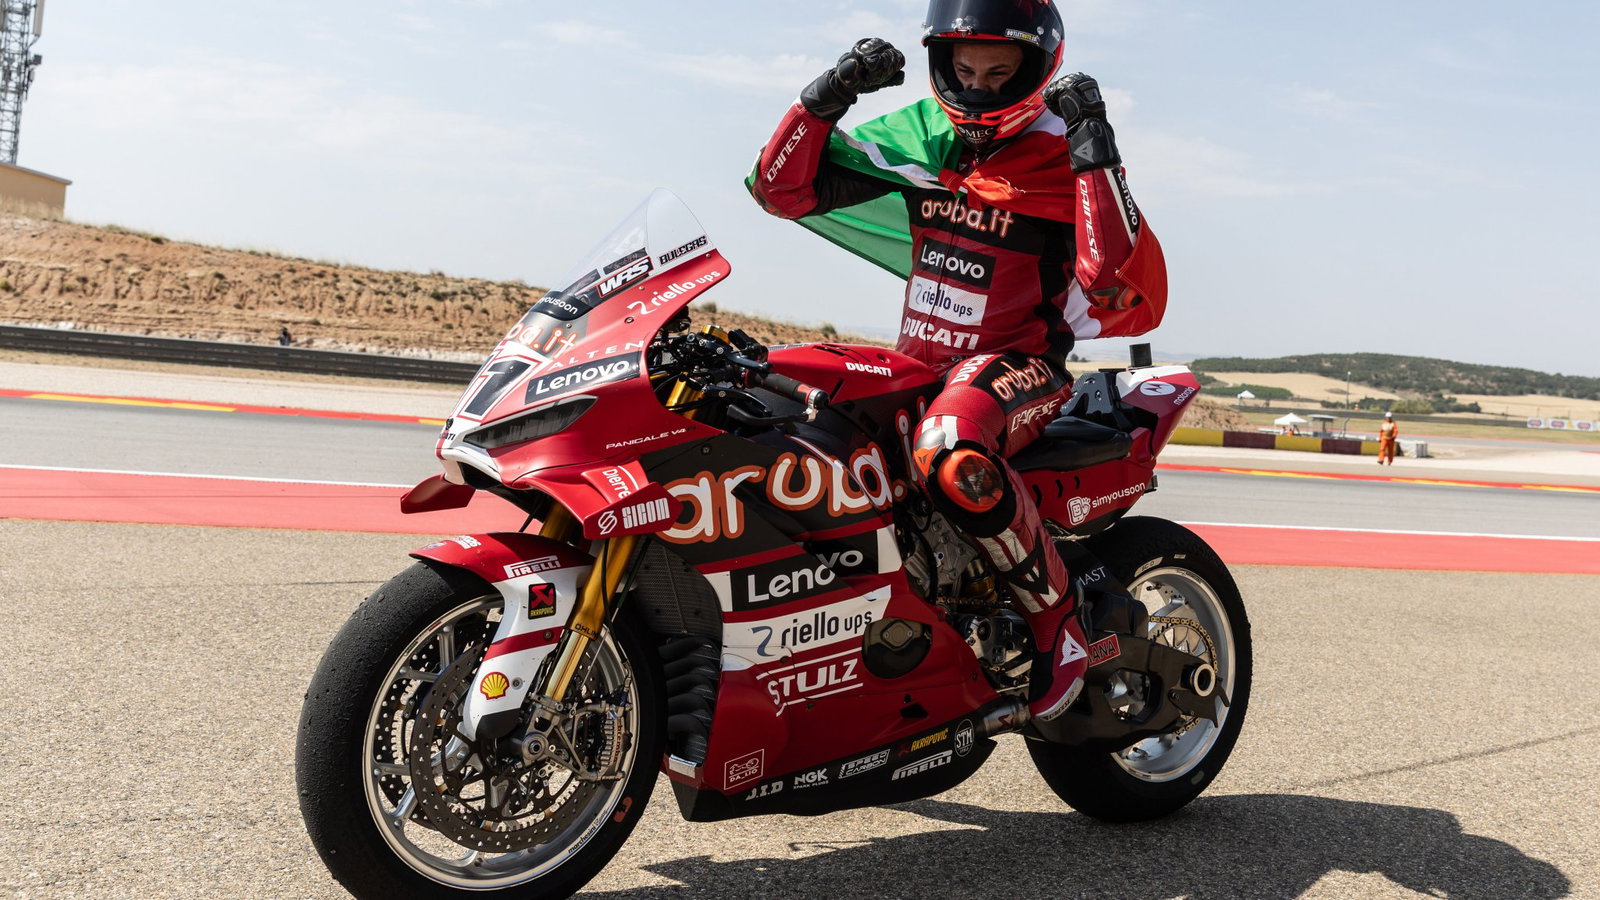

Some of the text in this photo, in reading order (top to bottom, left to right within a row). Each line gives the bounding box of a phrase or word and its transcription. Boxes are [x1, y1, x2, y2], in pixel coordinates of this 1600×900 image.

[766, 121, 808, 183] DAINESE
[1117, 172, 1138, 226] Lenovo
[921, 198, 1014, 239] aruba.it
[1079, 178, 1100, 263] DAINESE
[600, 258, 650, 296] WRS
[920, 244, 985, 279] Lenovo
[651, 270, 721, 307] riello ups
[953, 302, 973, 317] ups
[902, 316, 980, 350] DUCATI
[535, 360, 630, 395] Lenovo
[845, 361, 892, 377] DUCATI
[605, 431, 670, 449] PANIGALE
[671, 428, 687, 436] V4
[655, 396, 927, 545] aruba.i
[1092, 482, 1146, 508] simyousoon
[622, 498, 671, 529] SICOM
[503, 555, 561, 579] PIRELLI
[747, 550, 864, 603] Lenovo
[781, 610, 873, 648] riello ups
[767, 658, 858, 705] STULZ
[956, 727, 973, 749] STM
[793, 767, 828, 786] NGK
[846, 757, 887, 776] CARBON
[891, 749, 953, 780] PIRELLI
